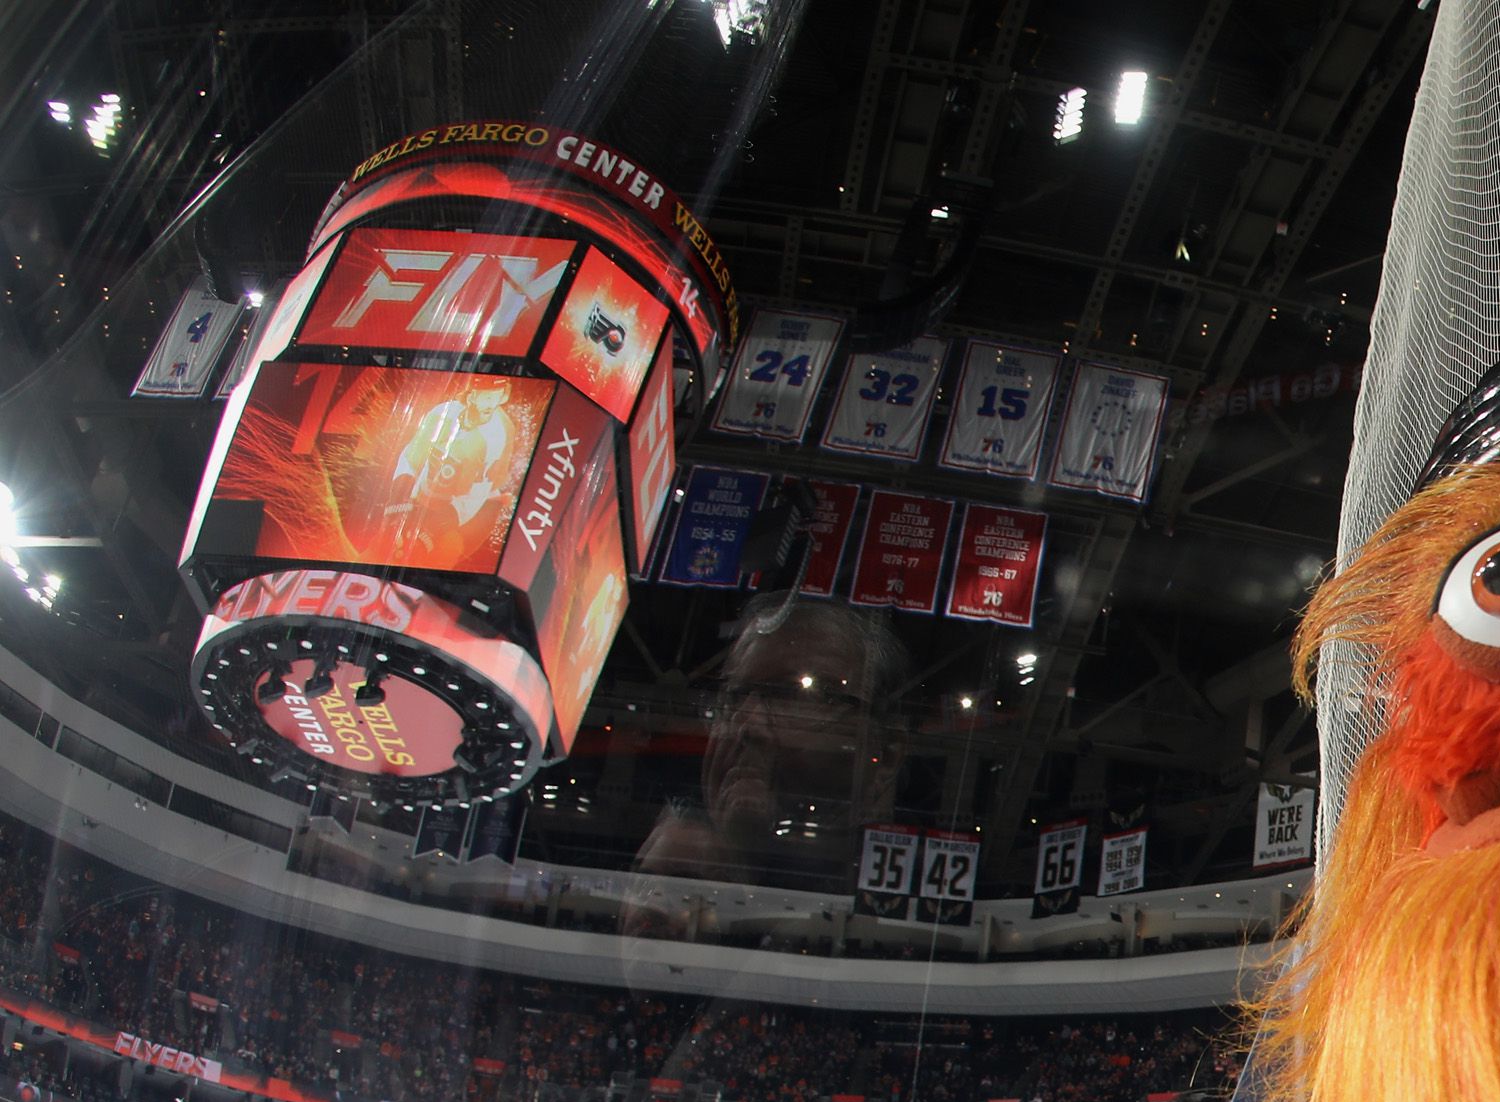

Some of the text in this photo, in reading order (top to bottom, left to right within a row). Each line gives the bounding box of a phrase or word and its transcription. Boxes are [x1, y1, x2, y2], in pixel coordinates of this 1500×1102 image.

[352, 122, 666, 210] WELLS FARGO CENTER
[674, 199, 731, 293] WELLS
[332, 248, 570, 337] FLY
[680, 276, 700, 319] 14
[187, 311, 214, 344] 4
[751, 350, 813, 387] 24
[859, 368, 920, 407] 32
[752, 402, 776, 419] 76
[977, 386, 1030, 421] 15
[864, 422, 888, 438] 76
[982, 438, 1004, 454] 76
[1093, 455, 1114, 472] 76
[518, 427, 580, 552] xfinity
[708, 489, 744, 504] WORLD
[690, 501, 752, 519] CHAMPIONS
[879, 522, 937, 540] CONFERENCE
[880, 533, 930, 550] CHAMPIONS
[984, 524, 1025, 540] EASTERN
[974, 536, 1031, 553] CONFERENCE
[975, 546, 1027, 563] CHAMPIONS
[886, 578, 905, 595] 76
[983, 590, 1004, 608] 76
[1267, 823, 1300, 845] BACK
[867, 844, 906, 890] 35
[926, 852, 970, 897] 42
[1041, 841, 1077, 888] 66
[115, 1031, 208, 1079] FLYERS
